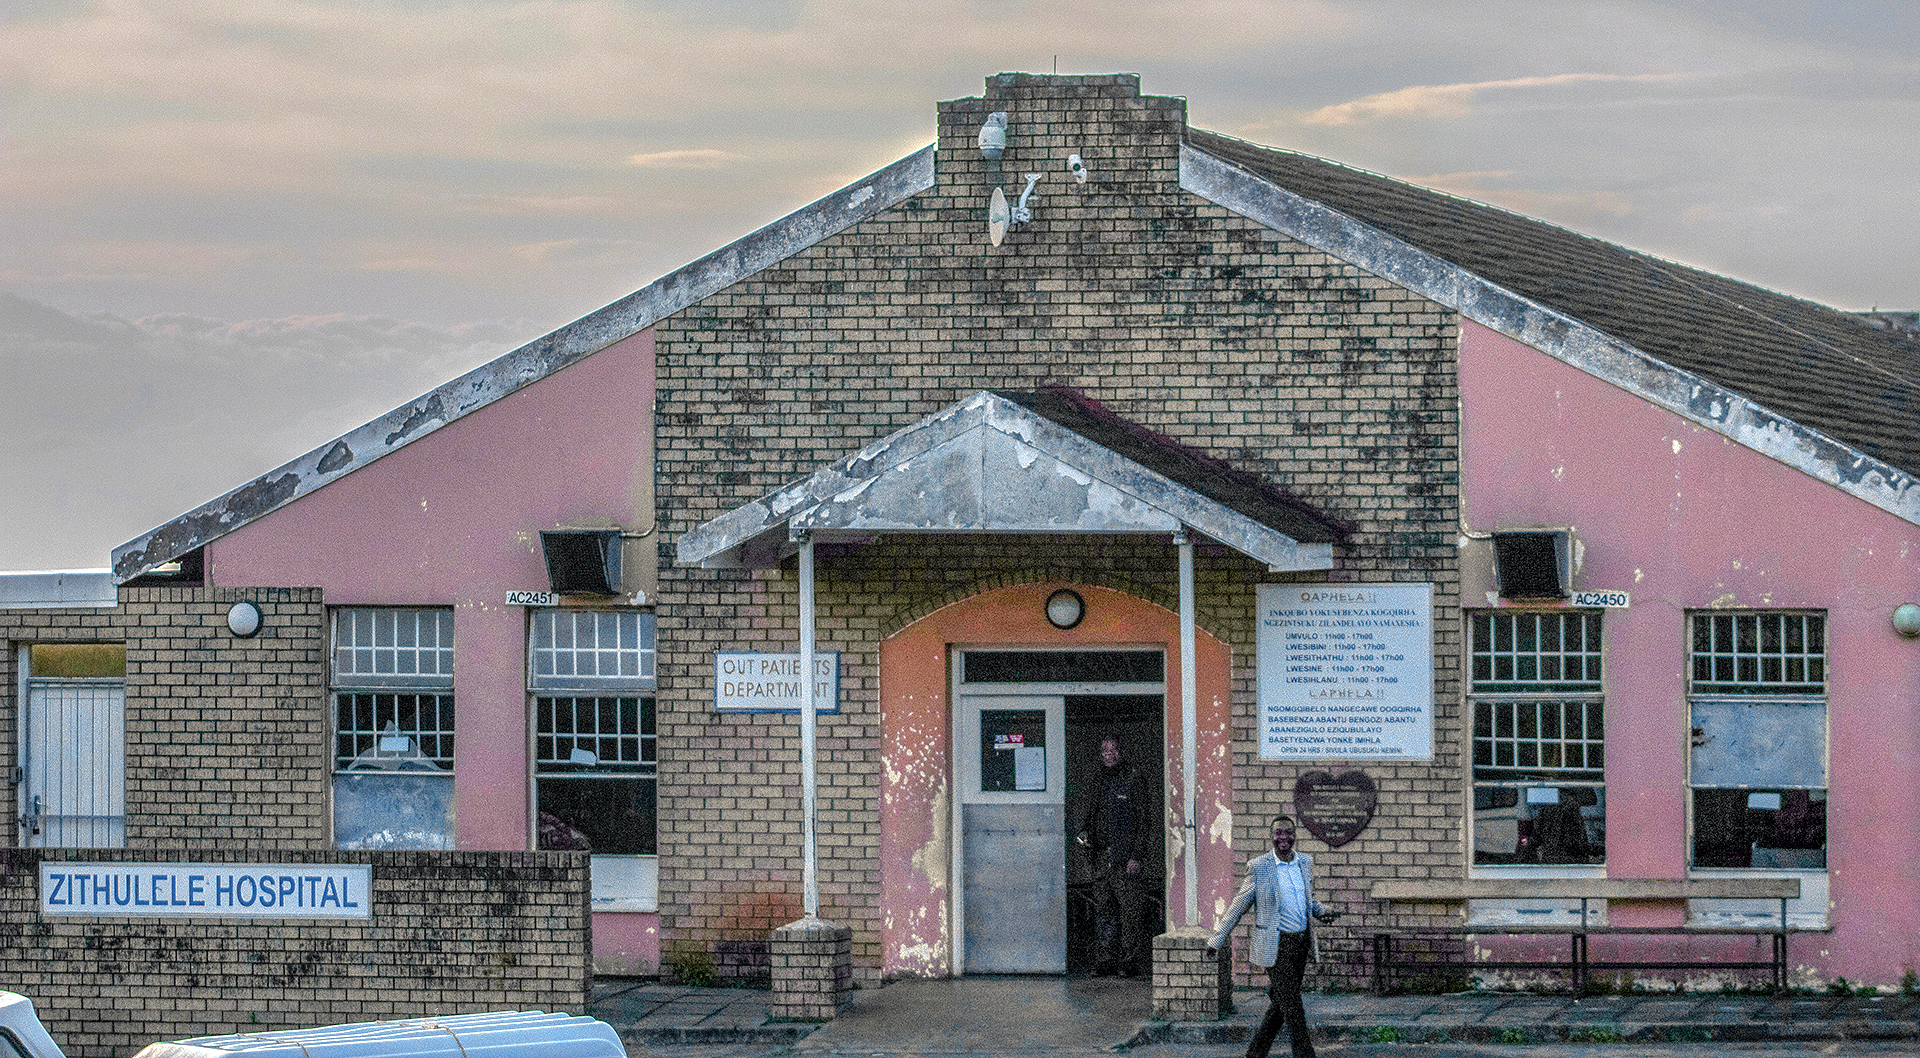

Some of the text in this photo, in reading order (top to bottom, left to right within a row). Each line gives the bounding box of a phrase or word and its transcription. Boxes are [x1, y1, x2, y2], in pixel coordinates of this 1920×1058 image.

[508, 591, 553, 604] AC2451
[1300, 592, 1364, 602] QAPHELA
[1575, 593, 1626, 606] AC2450
[1269, 609, 1307, 617] INKQUBO
[1370, 609, 1416, 617] KOGQIRHA
[1285, 643, 1326, 651] LWESIBINI
[1285, 654, 1344, 662] LWESITHATHU
[723, 659, 831, 676] OUT PATIETS
[1384, 716, 1416, 724] ABANTU
[1327, 726, 1382, 734] EZIQUBULAYO
[48, 873, 359, 908] ZITHULELE HOSPITAL
